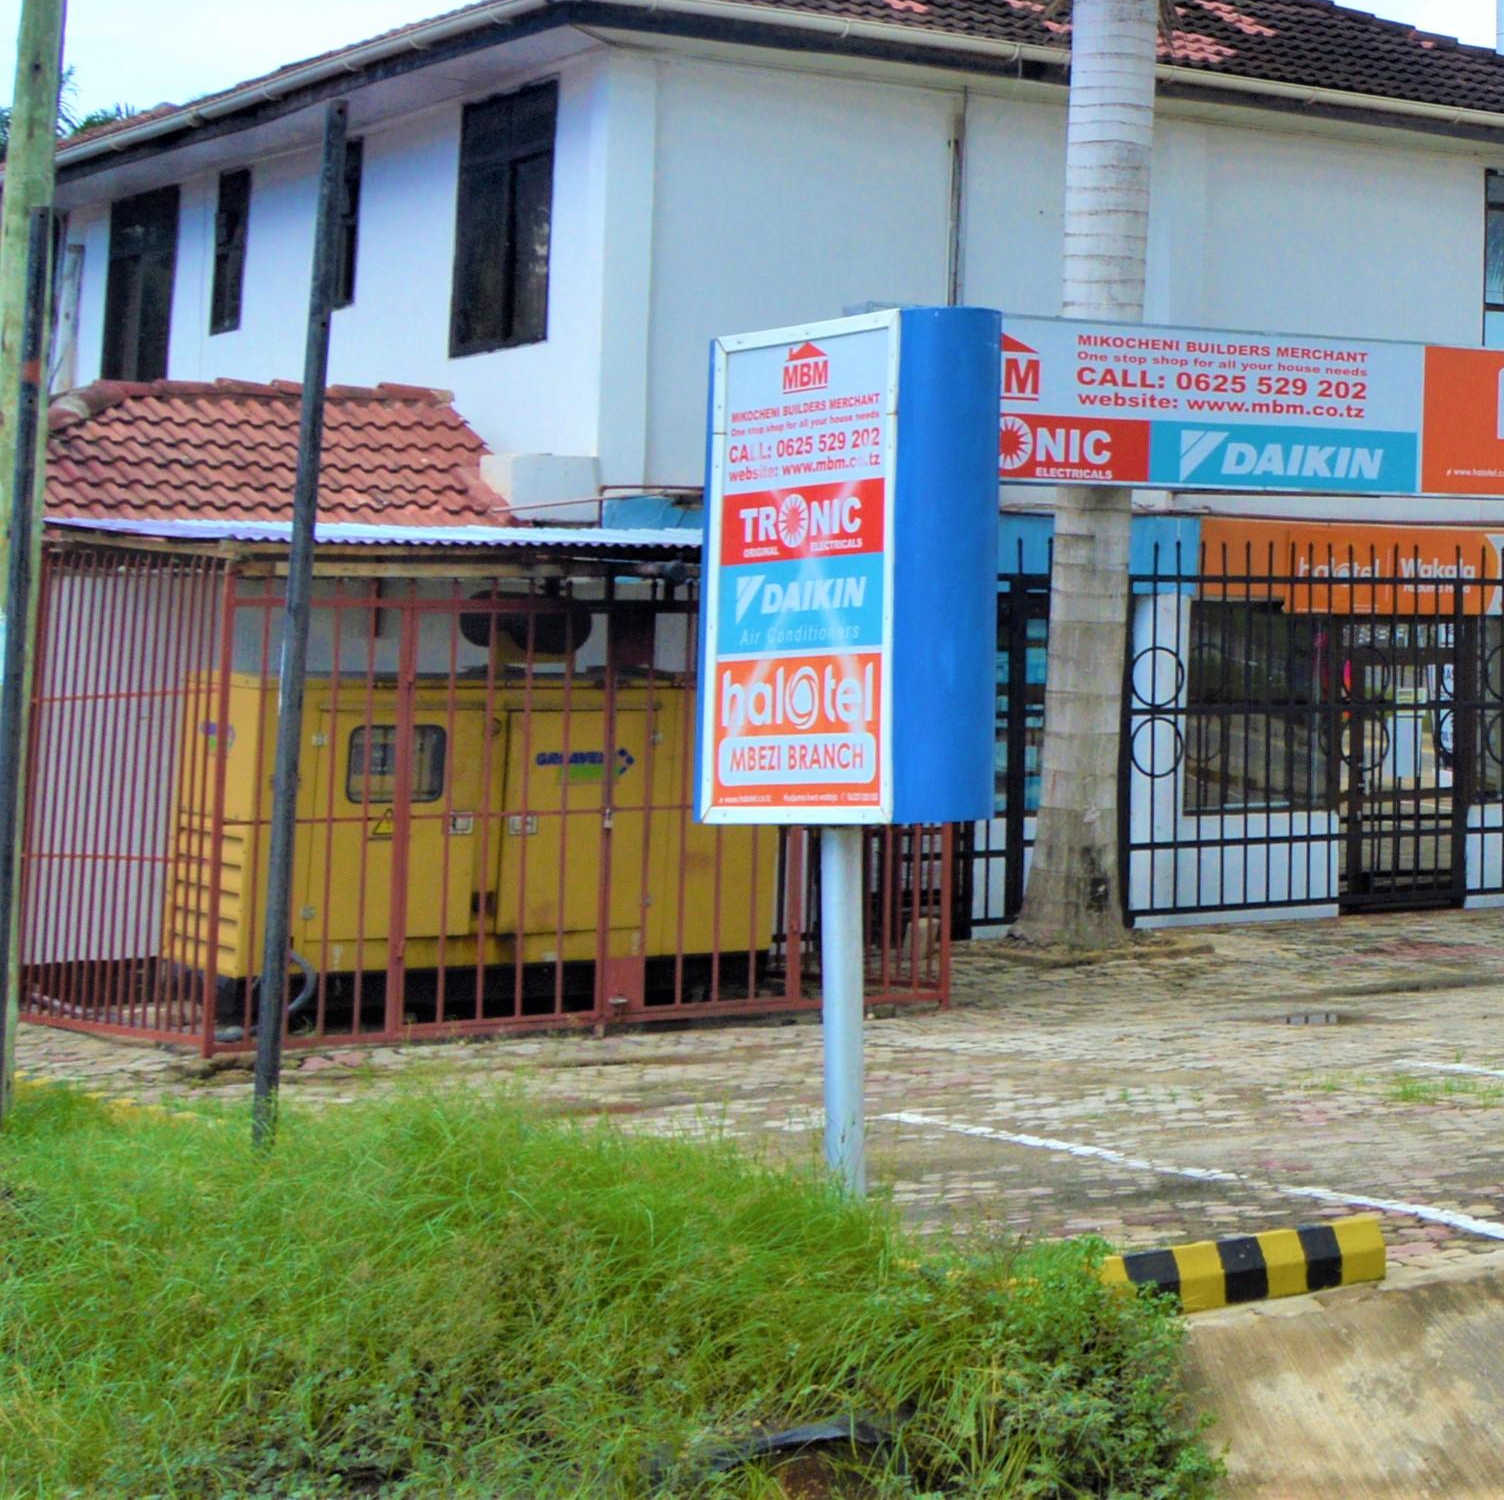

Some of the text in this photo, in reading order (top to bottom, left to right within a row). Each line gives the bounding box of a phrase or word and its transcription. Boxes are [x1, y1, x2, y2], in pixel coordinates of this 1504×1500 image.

[1077, 334, 1368, 363] MIKOCHENI BUILDERS MERCHANT
[783, 360, 829, 391] MBM
[1000, 358, 1040, 395] M
[1077, 351, 1368, 377] One stop shop for all your house needs
[1076, 366, 1367, 400] CALL: 0625 529 202
[731, 393, 880, 423] MIKOCHENI BUILDERS MERCHANT
[1078, 393, 1365, 419] website: www.mbm.co.tz
[731, 411, 880, 437] One stop shop for all your house needs
[776, 436, 813, 458] 0625
[818, 432, 845, 453] 529
[851, 427, 880, 449] 202
[782, 452, 880, 476] www.mbm.c.tz
[1035, 467, 1113, 480] ELECTRICALS
[1221, 442, 1384, 480] DAIKIN
[739, 493, 862, 548] TRONIC
[809, 538, 863, 551] ELECTRICALS
[1401, 557, 1476, 580] Wakala
[760, 576, 867, 614] DAIKIN
[740, 629, 761, 646] Air
[722, 661, 874, 730] halotel
[730, 742, 864, 772] MBEZI BRANCH
